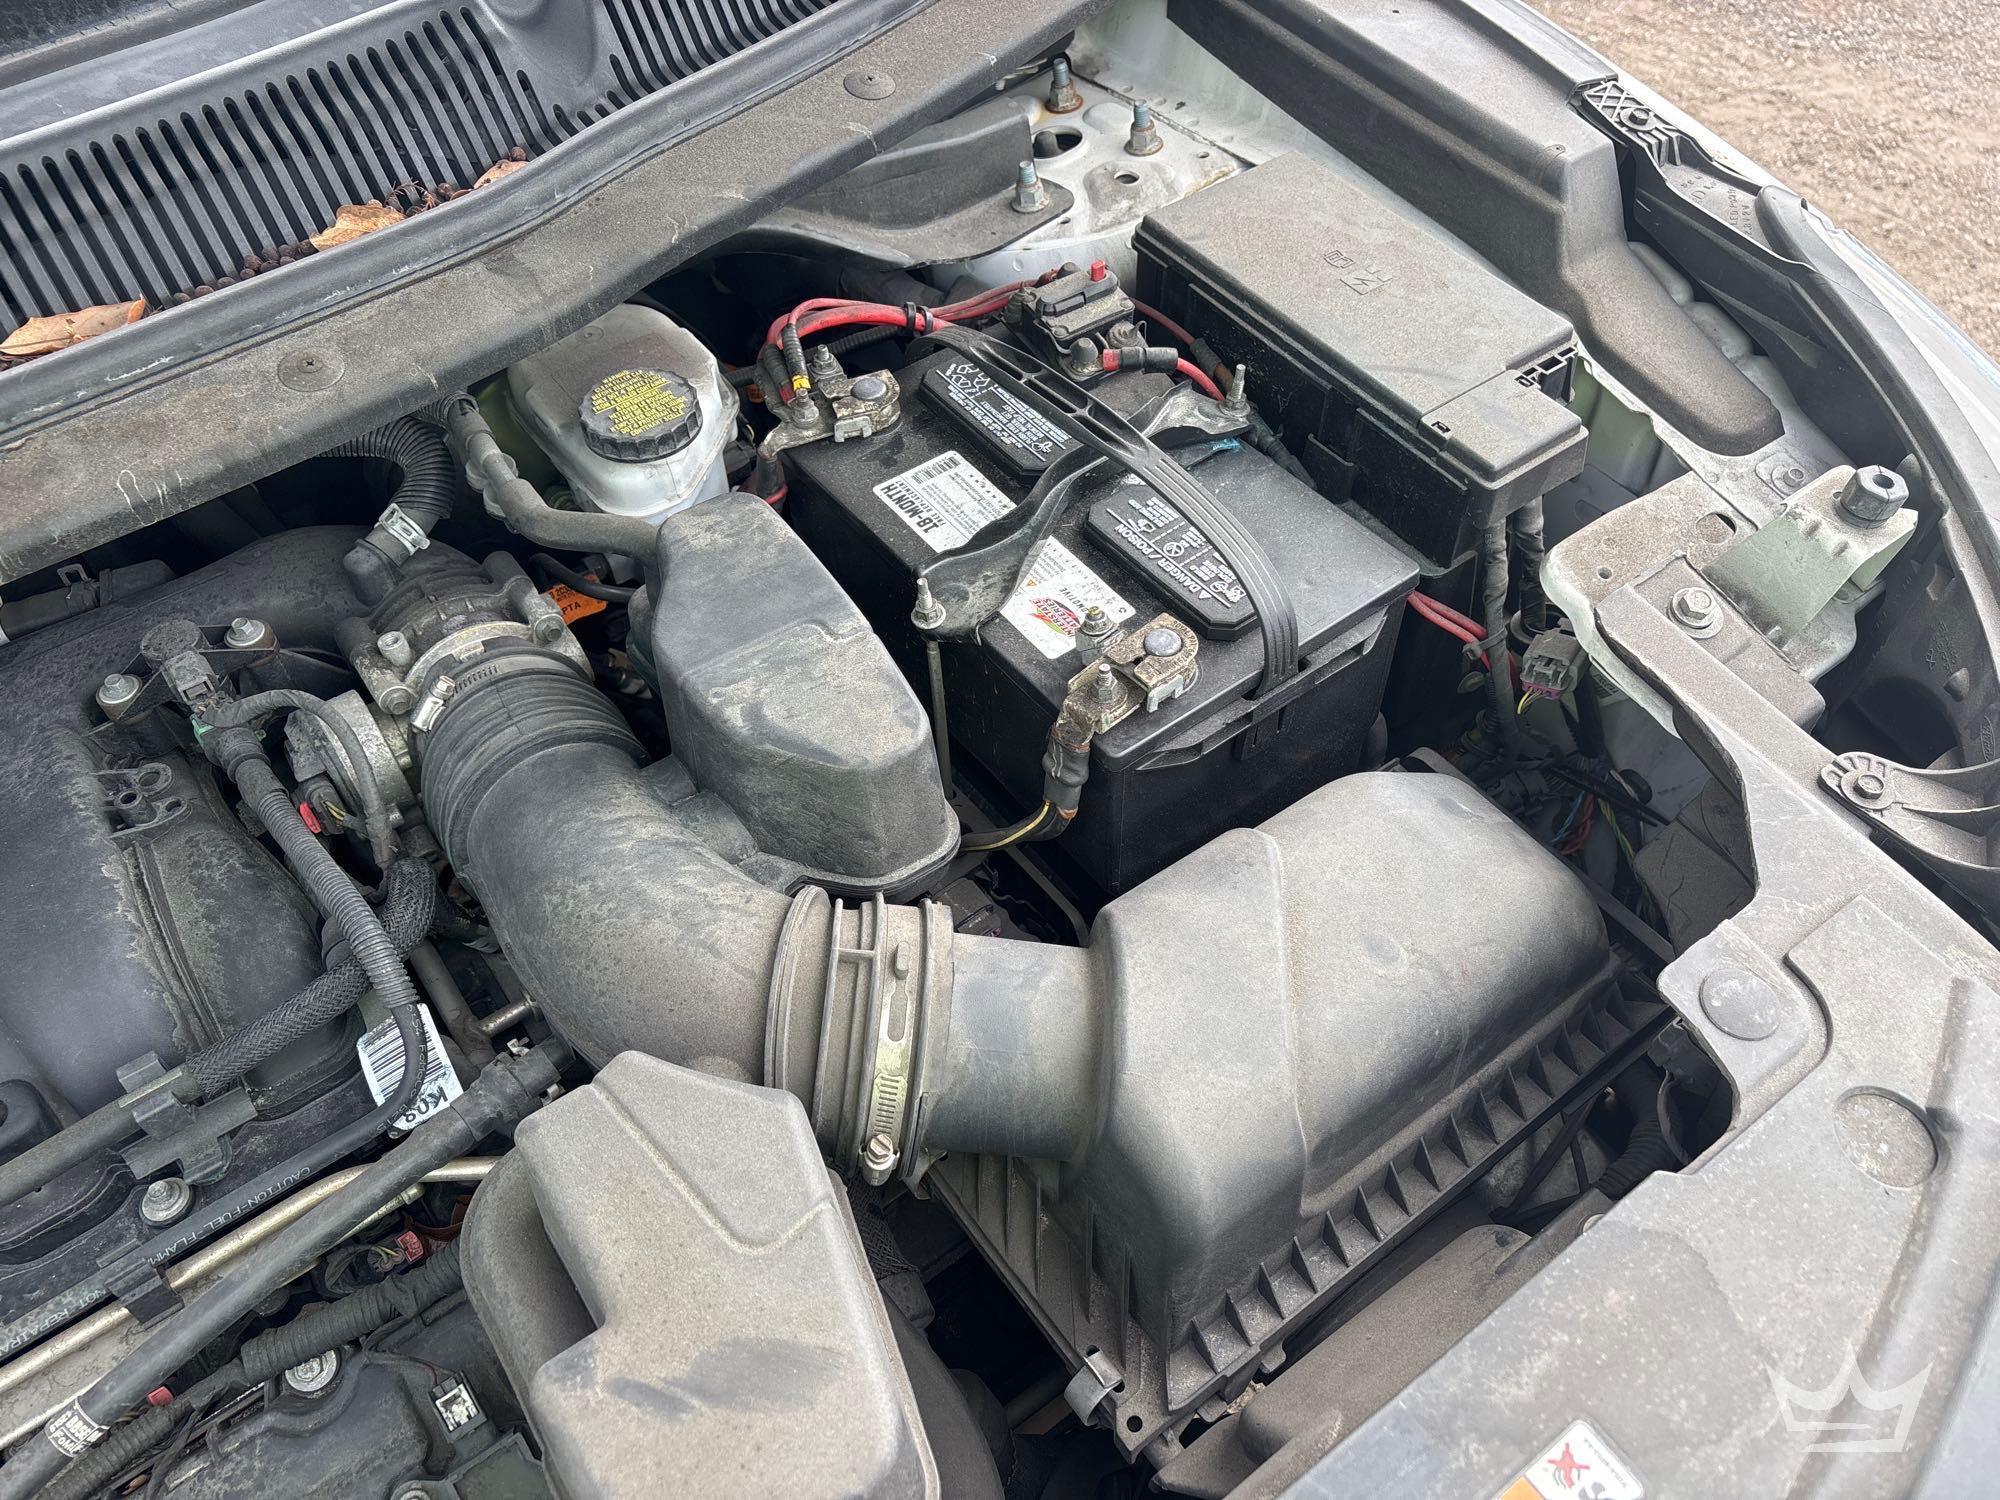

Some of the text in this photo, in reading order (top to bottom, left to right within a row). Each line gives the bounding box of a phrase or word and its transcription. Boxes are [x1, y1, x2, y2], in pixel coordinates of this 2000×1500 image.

[879, 481, 939, 534] 18-MONTH
[894, 478, 932, 512] REPLACEMENT
[931, 512, 946, 525] FREE
[1113, 522, 1154, 555] POISON
[1156, 556, 1201, 593] DANGER
[1042, 597, 1079, 630] ATTERIES
[1059, 586, 1089, 613] OMOTIVE
[148, 1165, 311, 1265] CAUTION-FUEL-FLAMM
[0, 1307, 70, 1355] REPAIRA
